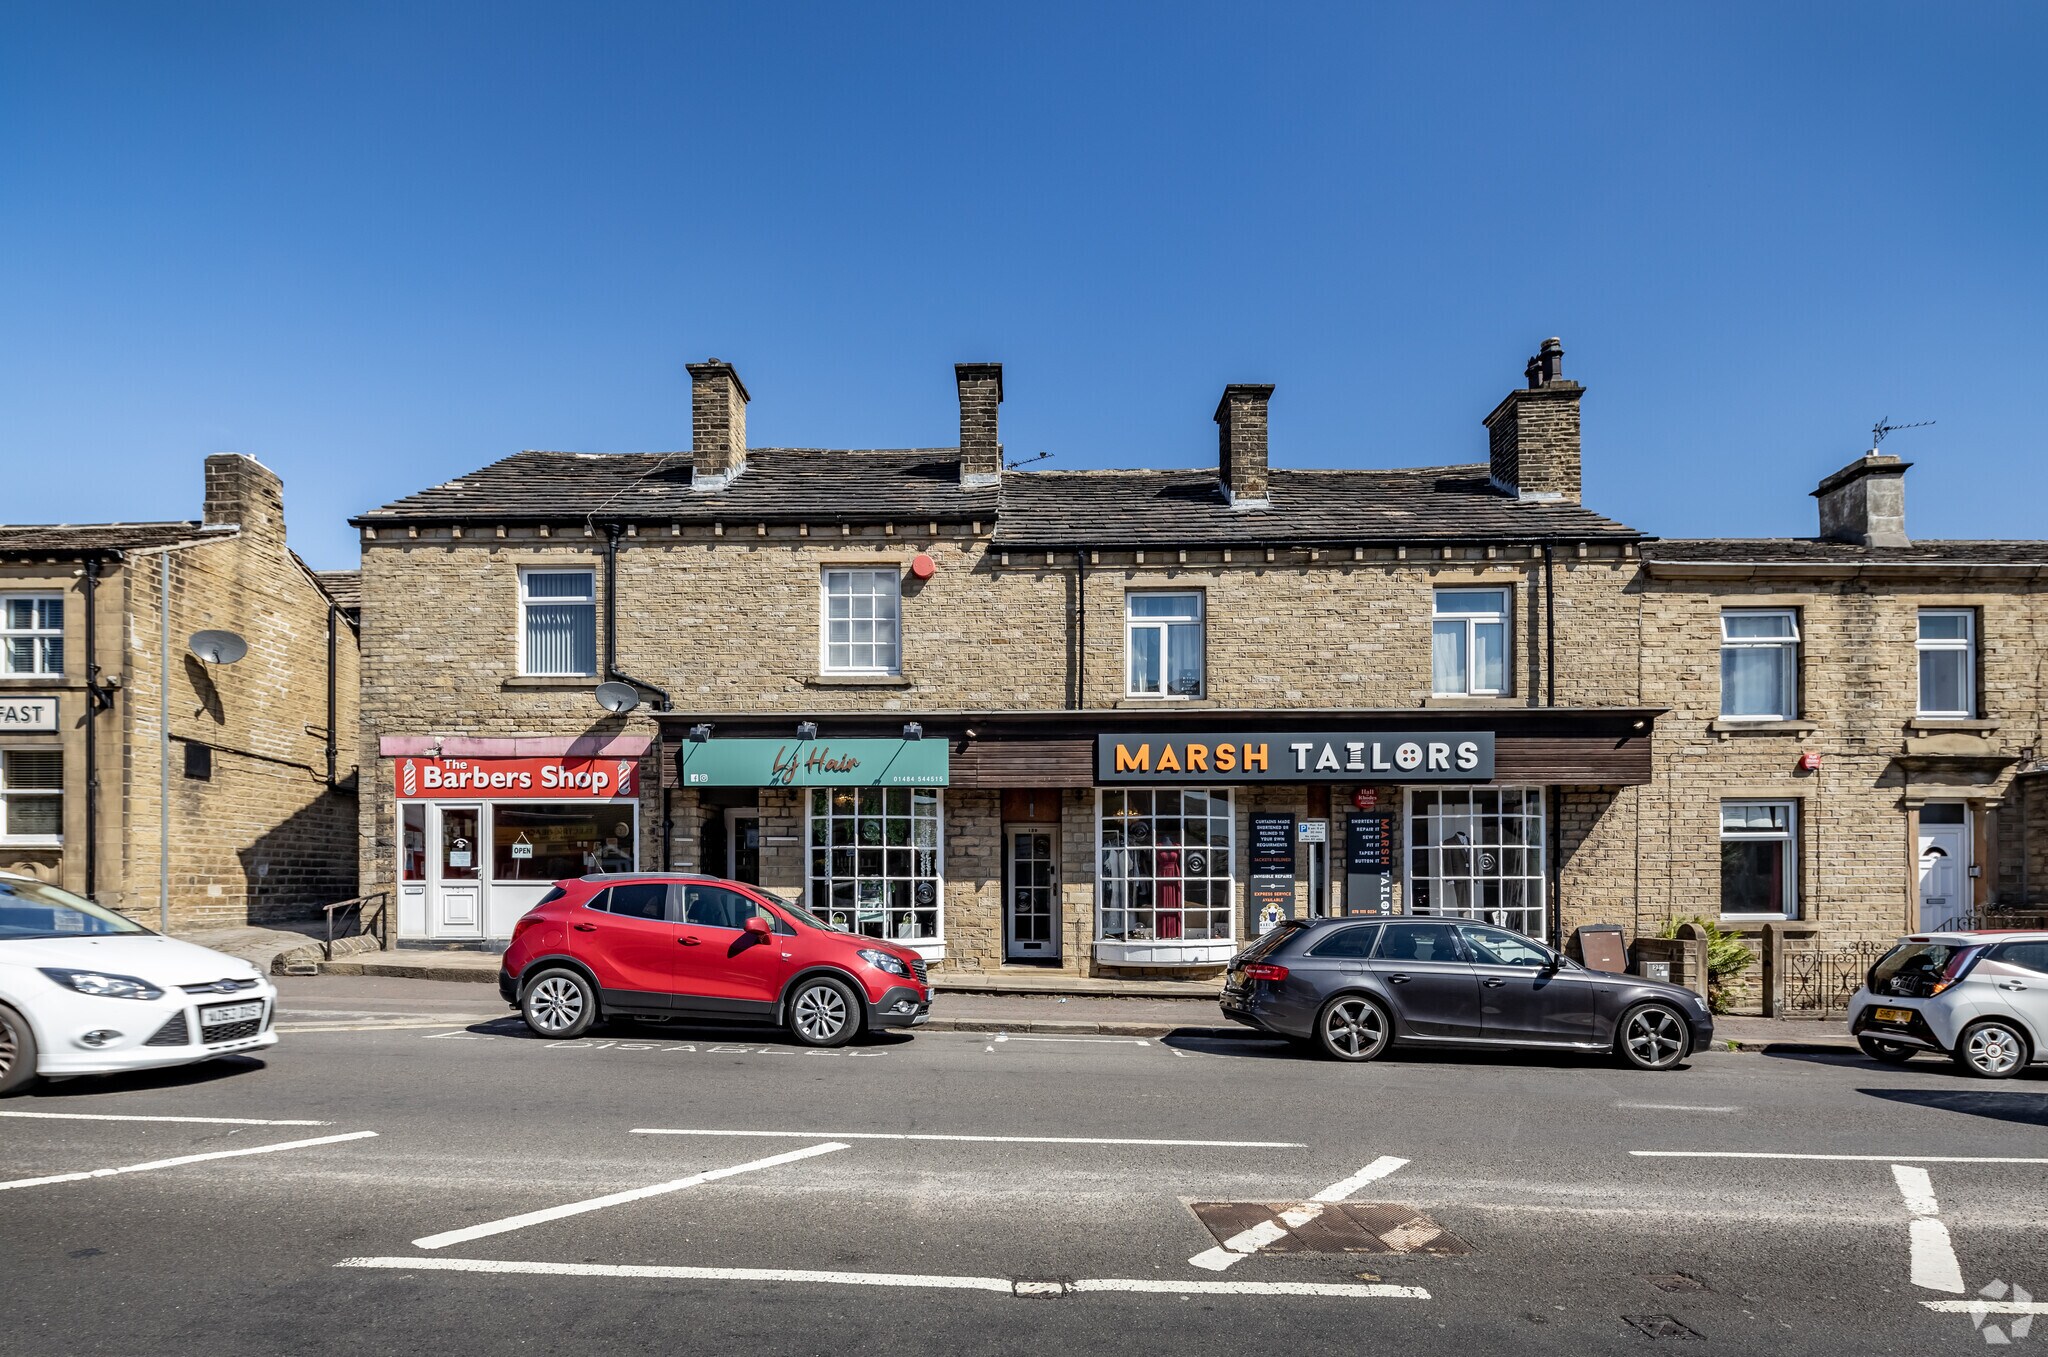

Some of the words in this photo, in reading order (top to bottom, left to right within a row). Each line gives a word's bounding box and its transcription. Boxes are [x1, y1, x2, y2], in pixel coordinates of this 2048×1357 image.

[443, 759, 467, 770] The
[805, 746, 860, 774] Hair
[1115, 743, 1268, 771] MARSH
[1290, 741, 1479, 771] TAILORS
[424, 766, 532, 789] Barbers
[541, 765, 609, 794] Shop
[1380, 819, 1390, 865] MARSH
[1380, 870, 1390, 916] TAILOR
[543, 1039, 888, 1057] DISABLED
